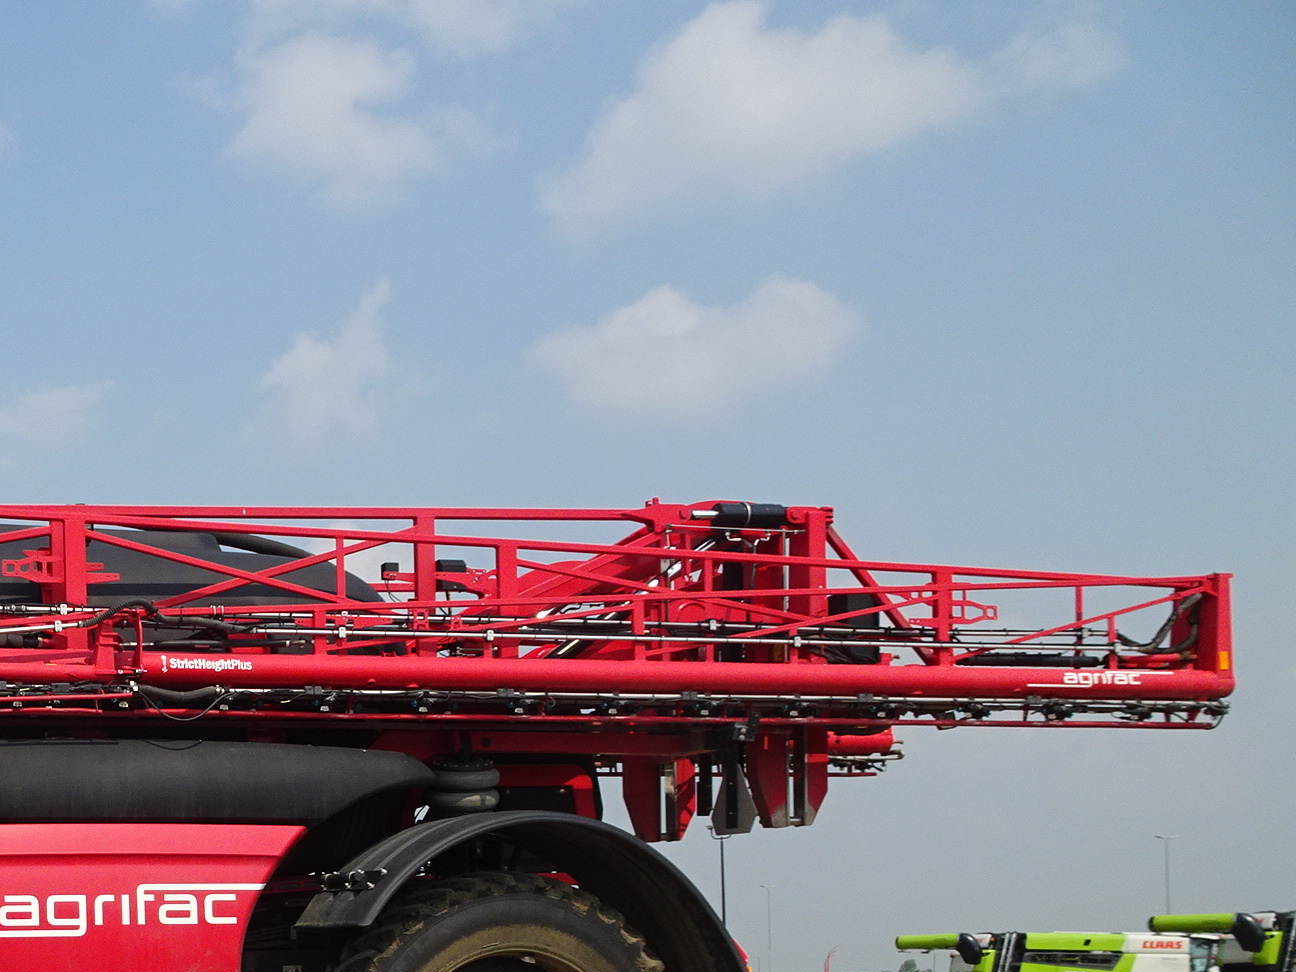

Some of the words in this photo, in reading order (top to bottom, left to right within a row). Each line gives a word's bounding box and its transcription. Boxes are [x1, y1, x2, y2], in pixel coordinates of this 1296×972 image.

[169, 657, 253, 672] StrictHeightPlus
[1056, 671, 1149, 688] agrifac
[1141, 940, 1183, 949] CLAAS
